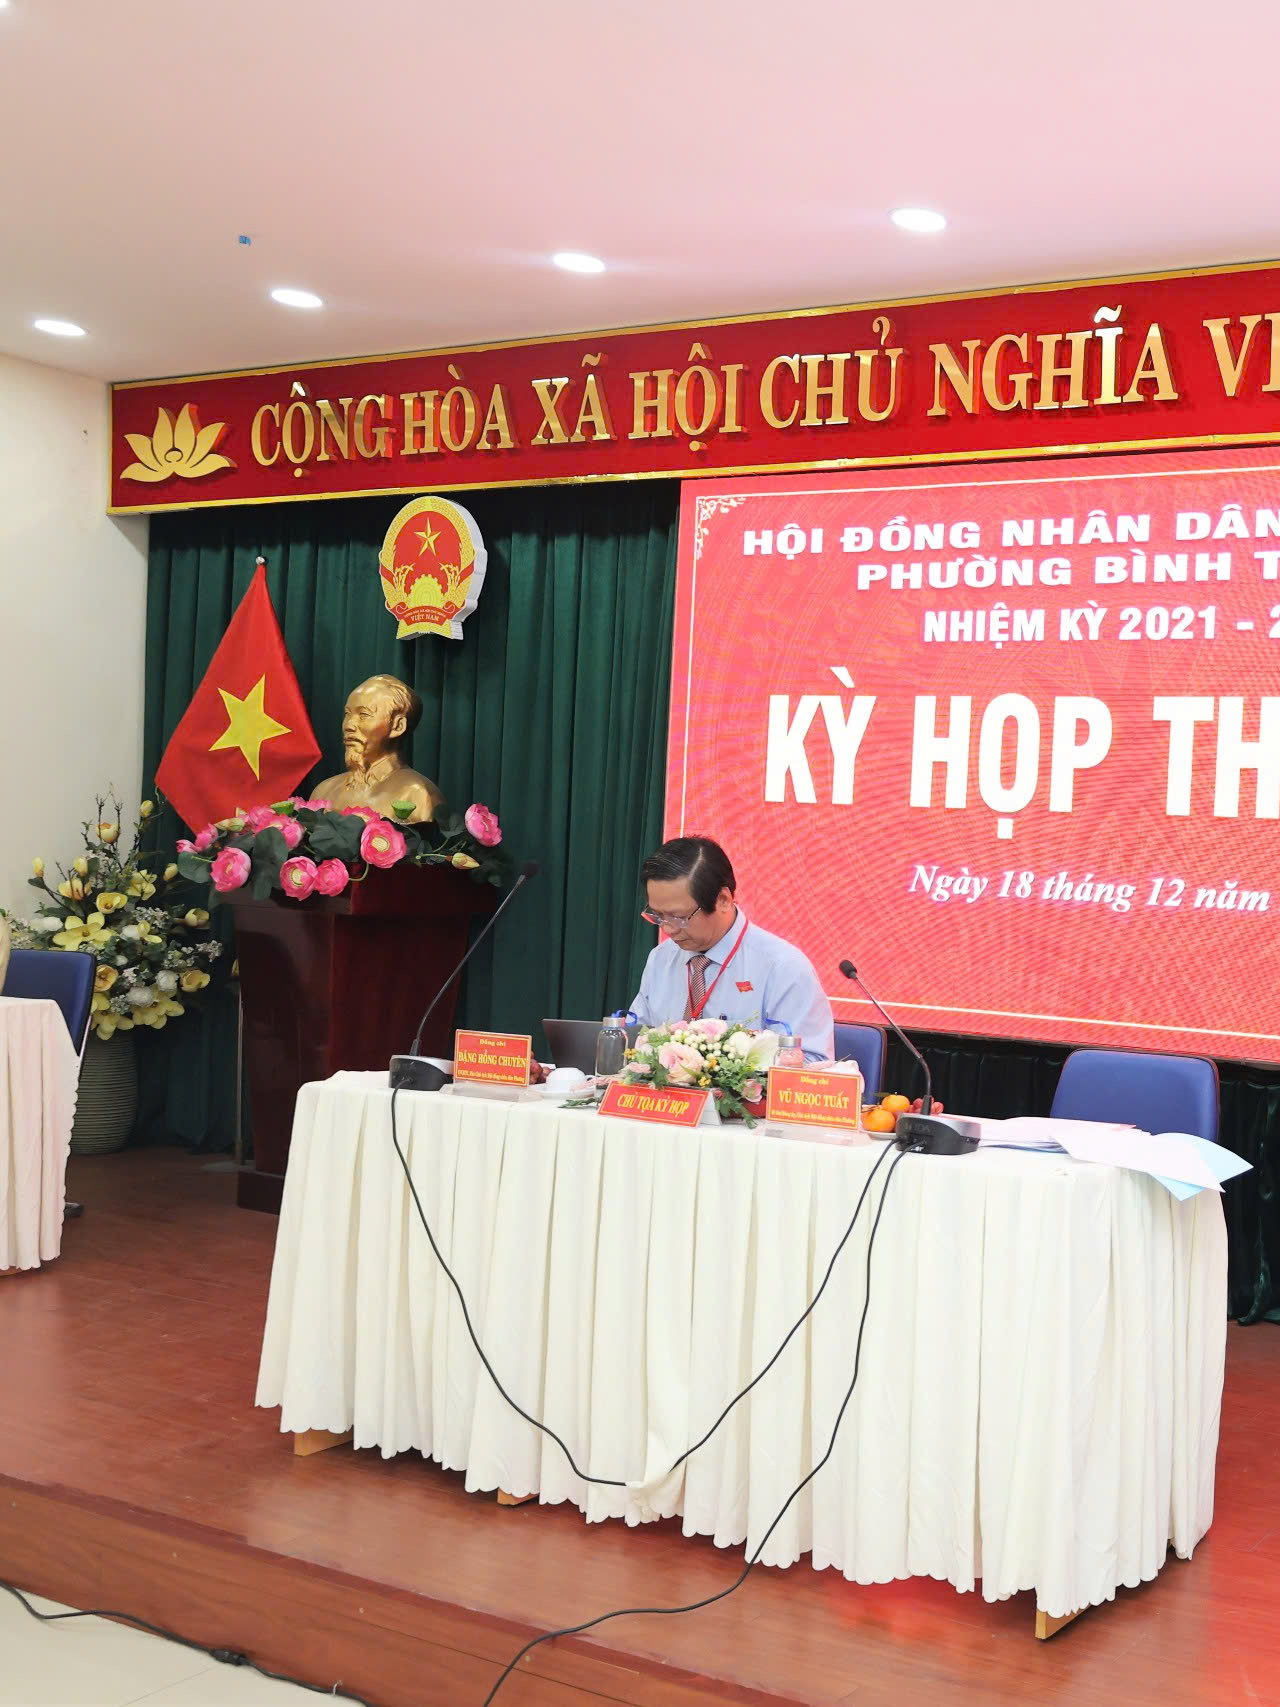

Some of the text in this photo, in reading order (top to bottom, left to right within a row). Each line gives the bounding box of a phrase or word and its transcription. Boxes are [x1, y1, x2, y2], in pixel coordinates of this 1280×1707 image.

[252, 383, 391, 478] CỘNG
[400, 366, 514, 456] HÒA
[531, 353, 612, 446] XÃ
[629, 343, 744, 451] HỘI
[759, 316, 903, 429] CHỦ
[926, 304, 1178, 417] NGHĨA
[743, 523, 824, 560] HỘI
[840, 516, 981, 553] ĐỒNG
[1001, 510, 1150, 547] NHÂN
[856, 554, 1072, 591] PHƯỜNG
[1094, 549, 1232, 584] BÌNH
[923, 602, 1045, 650] NHIỆM
[1059, 600, 1106, 642] KỲ
[1119, 605, 1217, 643] 2021
[1237, 622, 1255, 631] -
[764, 666, 878, 806] KỲ
[910, 693, 1114, 840] HỌP
[909, 864, 989, 903] Ngày
[999, 869, 1035, 899] 18
[1044, 871, 1137, 913] tháng
[1147, 877, 1187, 908] 12
[1194, 881, 1271, 913] năm
[669, 1099, 690, 1118] HỌP
[794, 1092, 821, 1109] NGỌC
